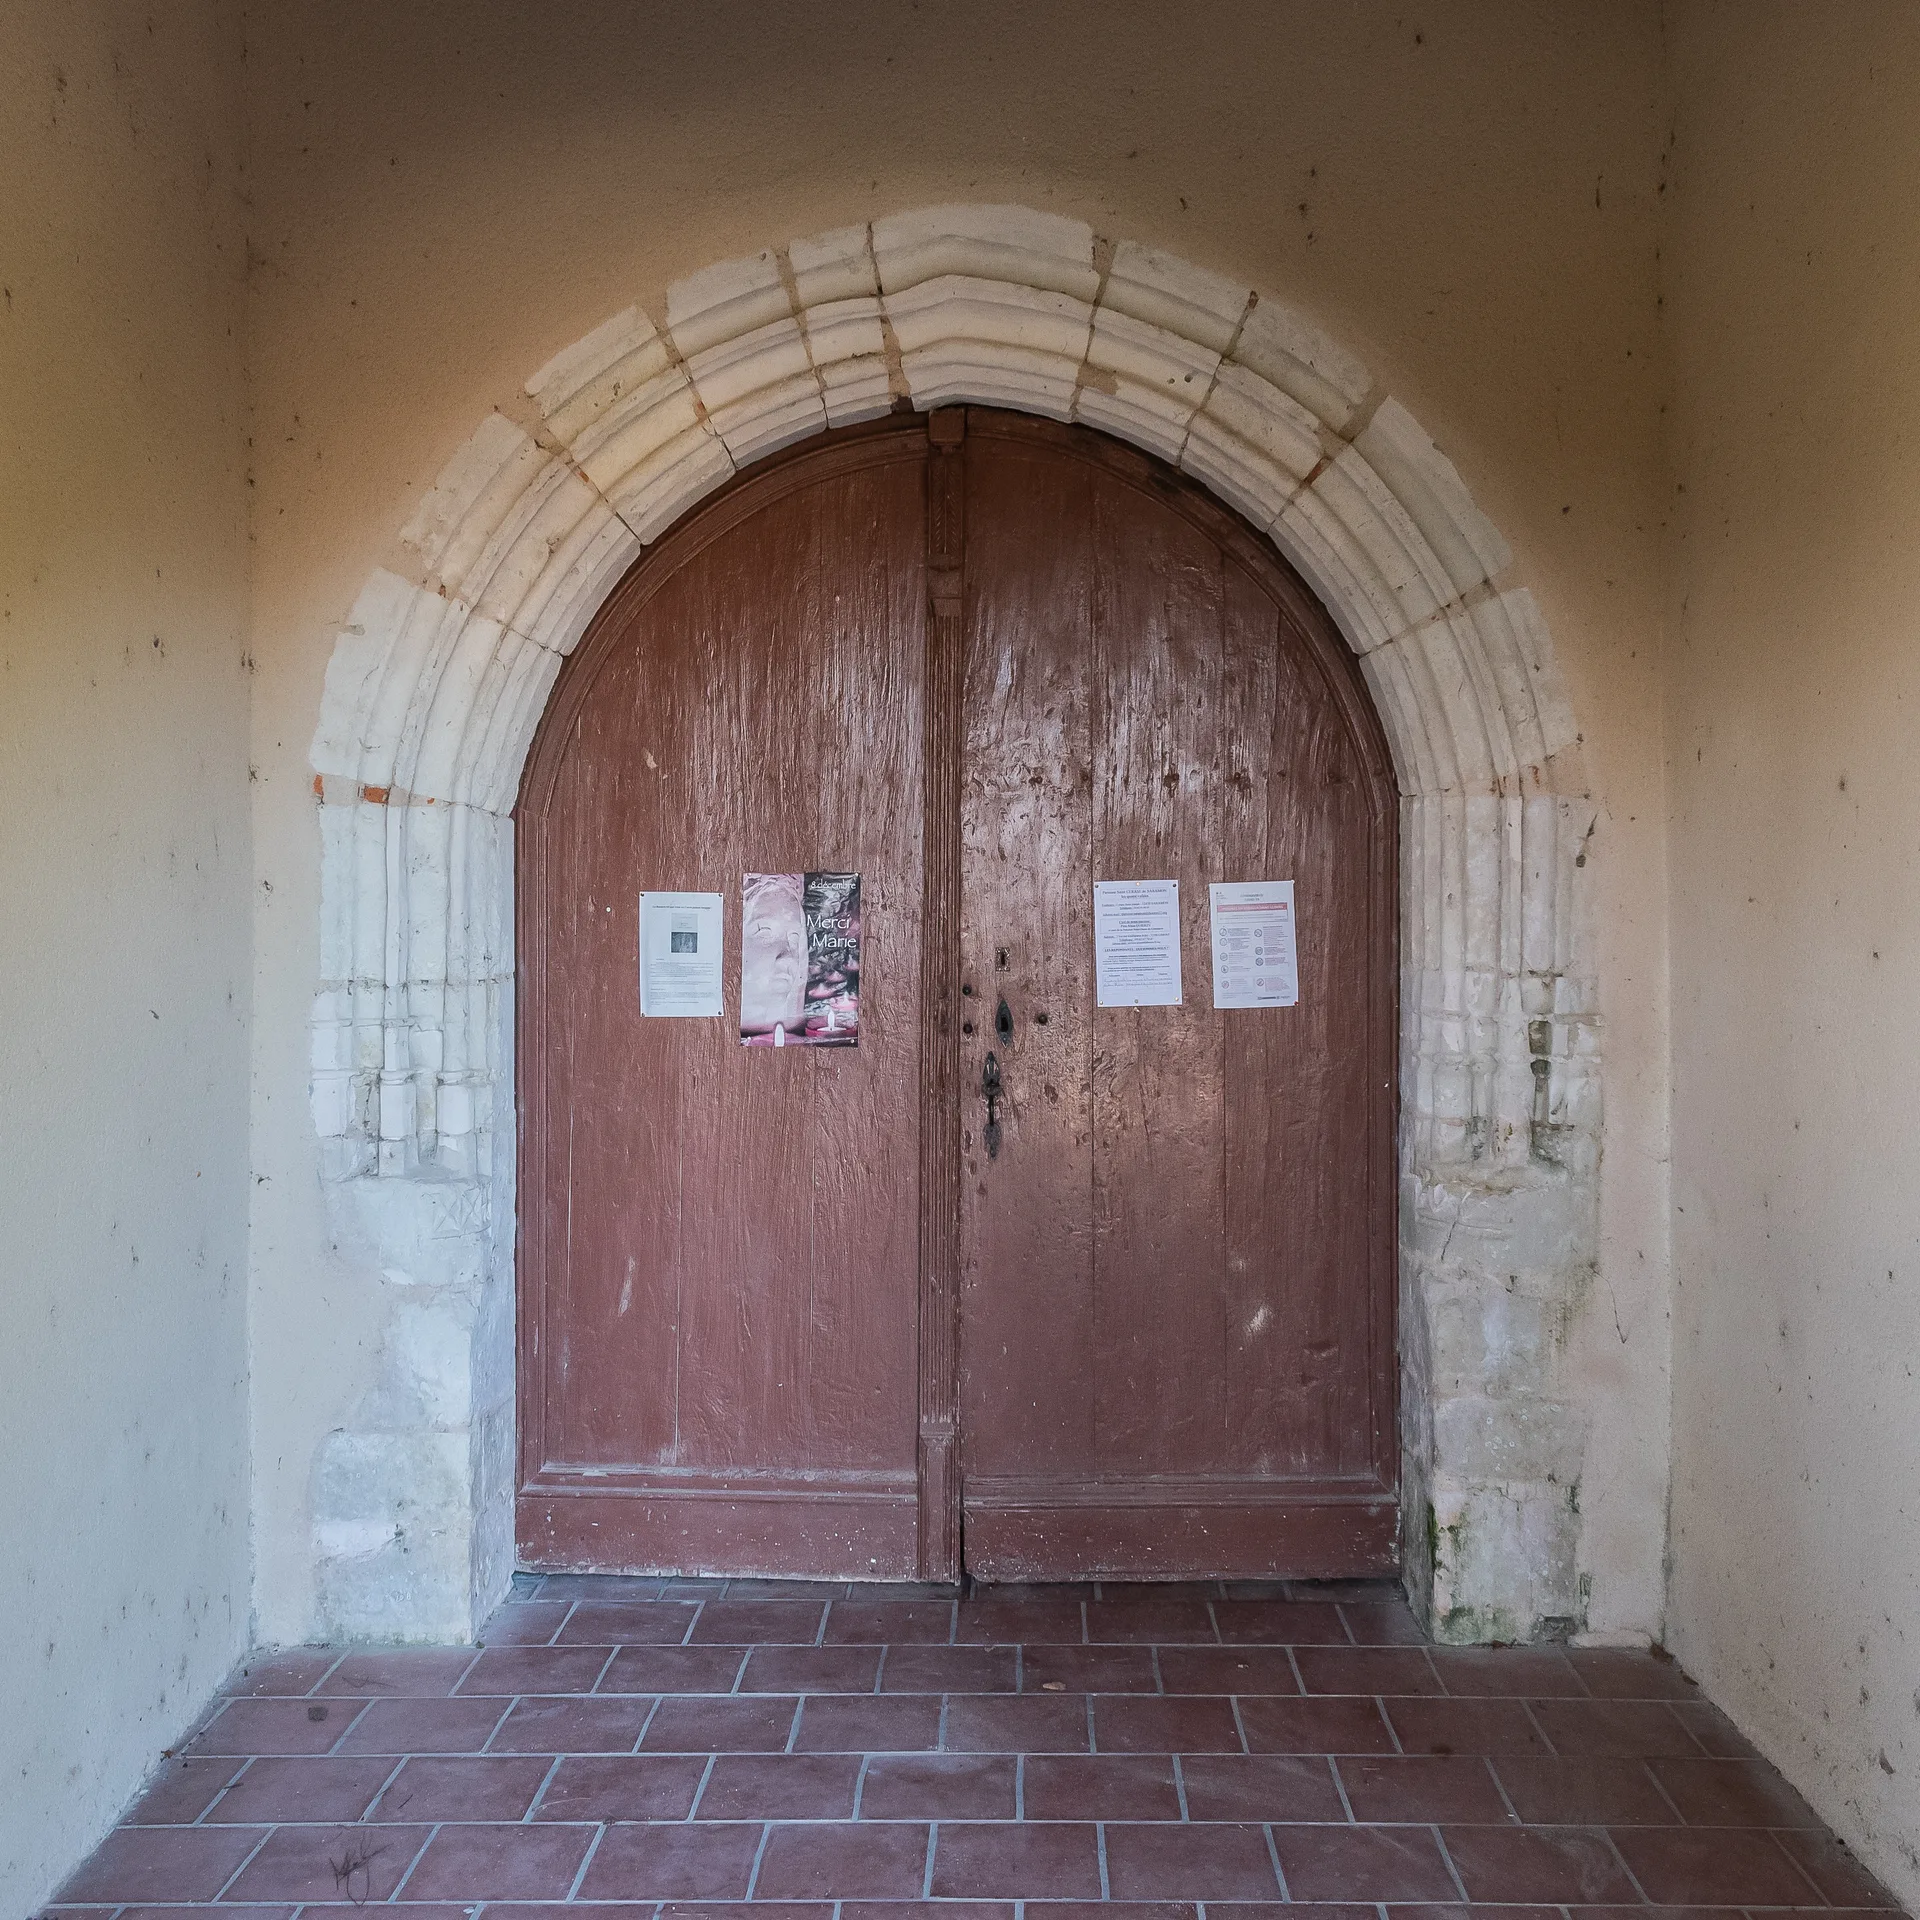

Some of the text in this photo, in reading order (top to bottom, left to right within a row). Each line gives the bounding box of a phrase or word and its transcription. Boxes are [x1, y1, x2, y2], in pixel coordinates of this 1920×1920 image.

[817, 879, 857, 889] décembre
[807, 914, 850, 929] Merci
[813, 931, 857, 948] Marie
